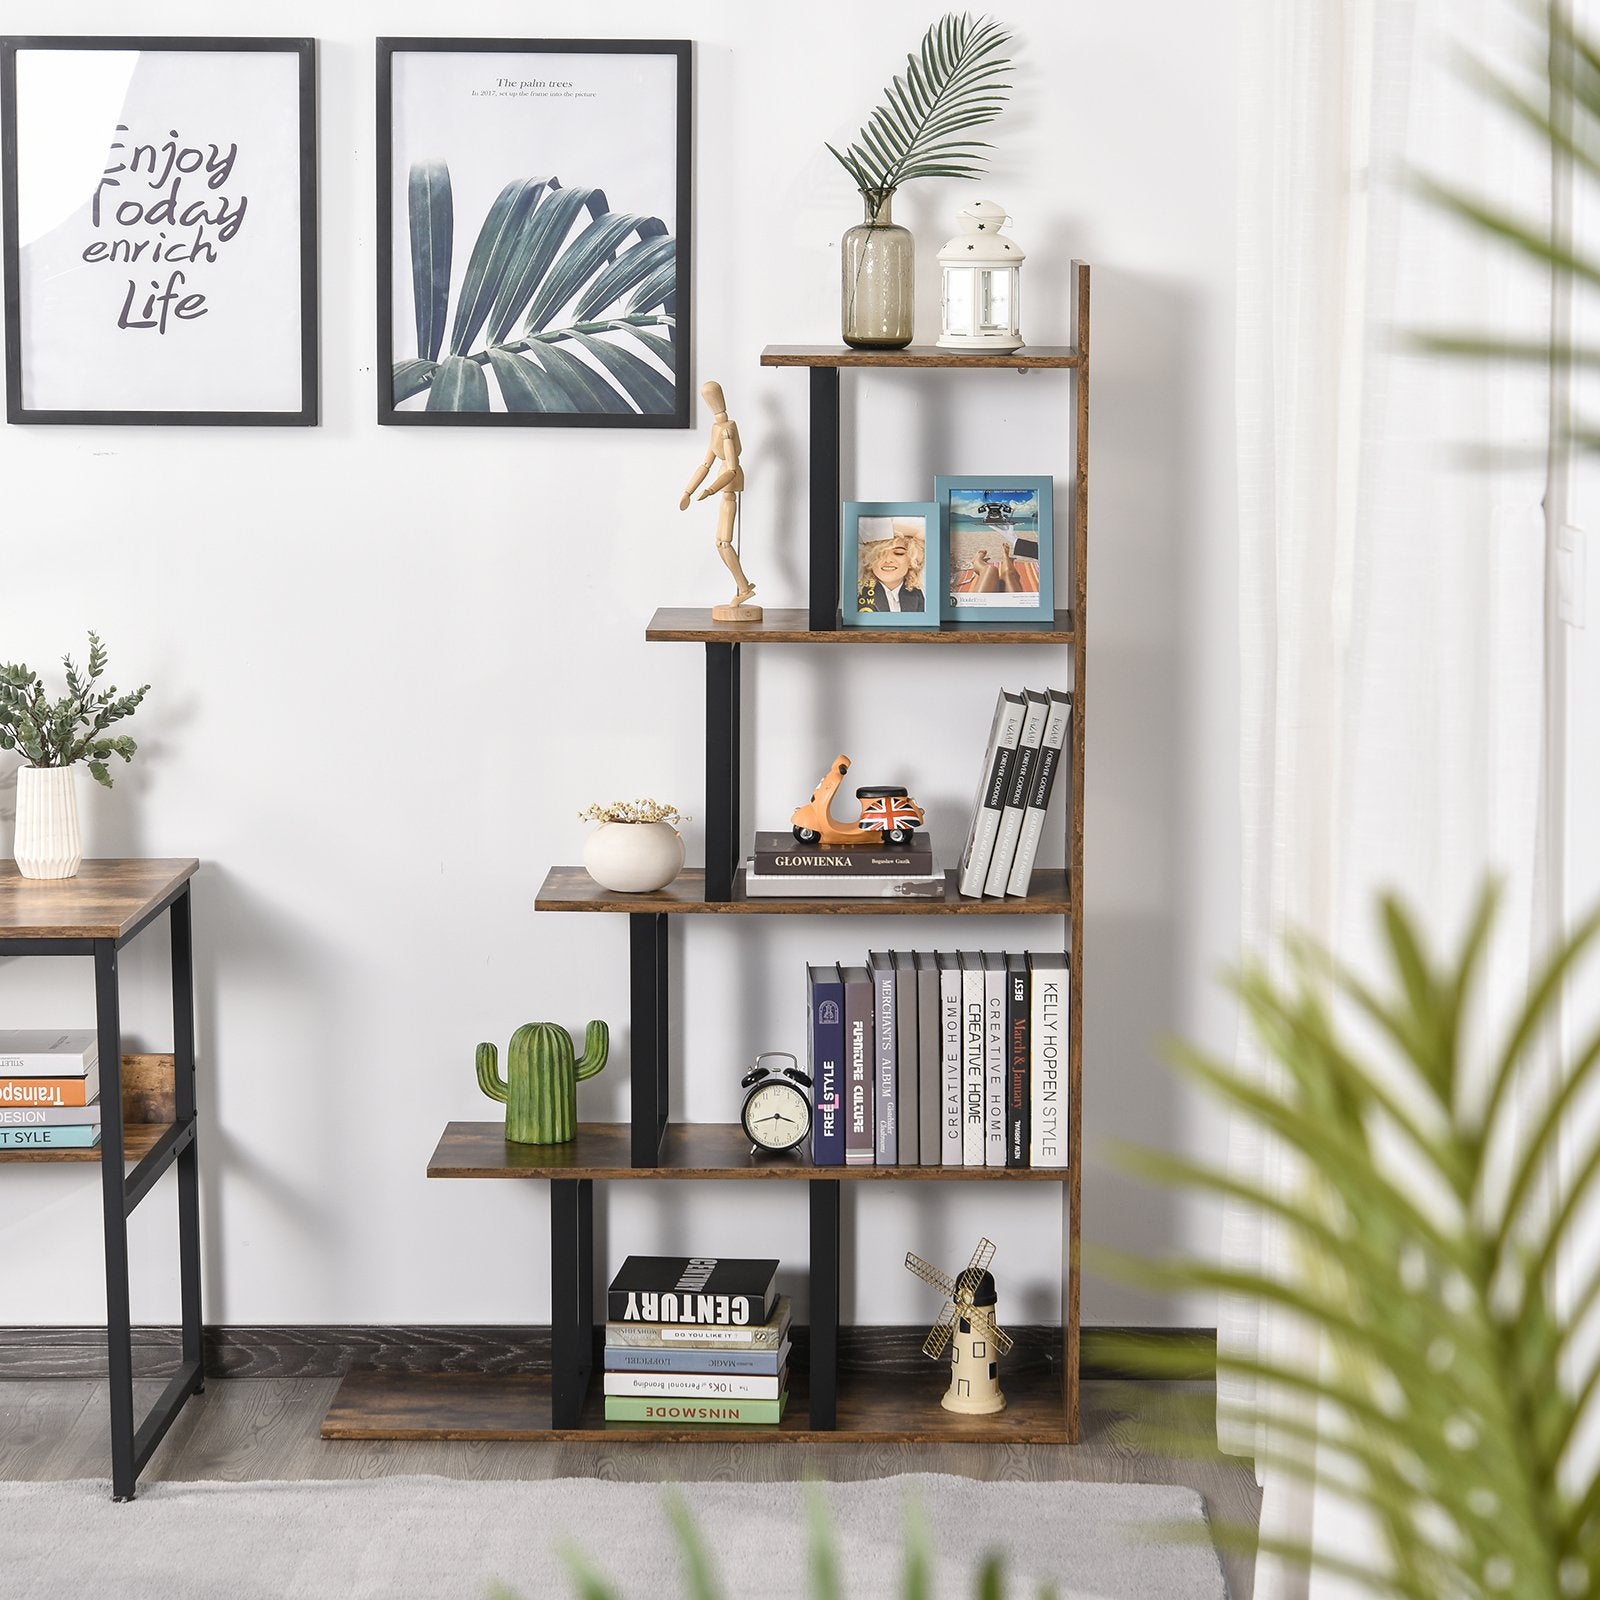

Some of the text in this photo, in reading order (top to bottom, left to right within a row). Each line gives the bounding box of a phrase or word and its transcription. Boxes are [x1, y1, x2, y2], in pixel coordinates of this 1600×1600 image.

[496, 78, 574, 89] The palm trees
[104, 124, 238, 190] Enjoy
[92, 177, 248, 242] Today
[82, 225, 218, 264] enrich
[118, 270, 208, 335] Life
[991, 750, 1009, 806] FOREVER GODDESS
[1013, 750, 1031, 804] FOREVER GODDESS
[1036, 750, 1054, 805] FOREVER GODDESS
[775, 856, 852, 867] GŁOWIENKA
[1015, 978, 1023, 1001] BEST
[882, 980, 892, 1097] MERCHANTS ALBUM
[1014, 1019, 1026, 1053] March
[853, 1021, 864, 1133] FURNITURE CULTURE
[947, 996, 958, 1139] CREATIVE HOME
[968, 1003, 981, 1124] CREATIVE HOME
[990, 998, 1001, 1142] CREATIVE HOME
[1014, 1057, 1024, 1066] &
[1042, 982, 1058, 1156] KELLY HOPPEN STYLE
[824, 1061, 834, 1137] FREE STYLE
[15, 1131, 52, 1142] SYLE
[623, 1292, 750, 1325] CENTURY
[633, 1380, 665, 1388] Branding
[668, 1382, 700, 1390] Personal
[708, 1359, 736, 1367] MAGIC
[708, 1383, 732, 1392] 10Ks
[646, 1406, 740, 1419] NINSMODE
